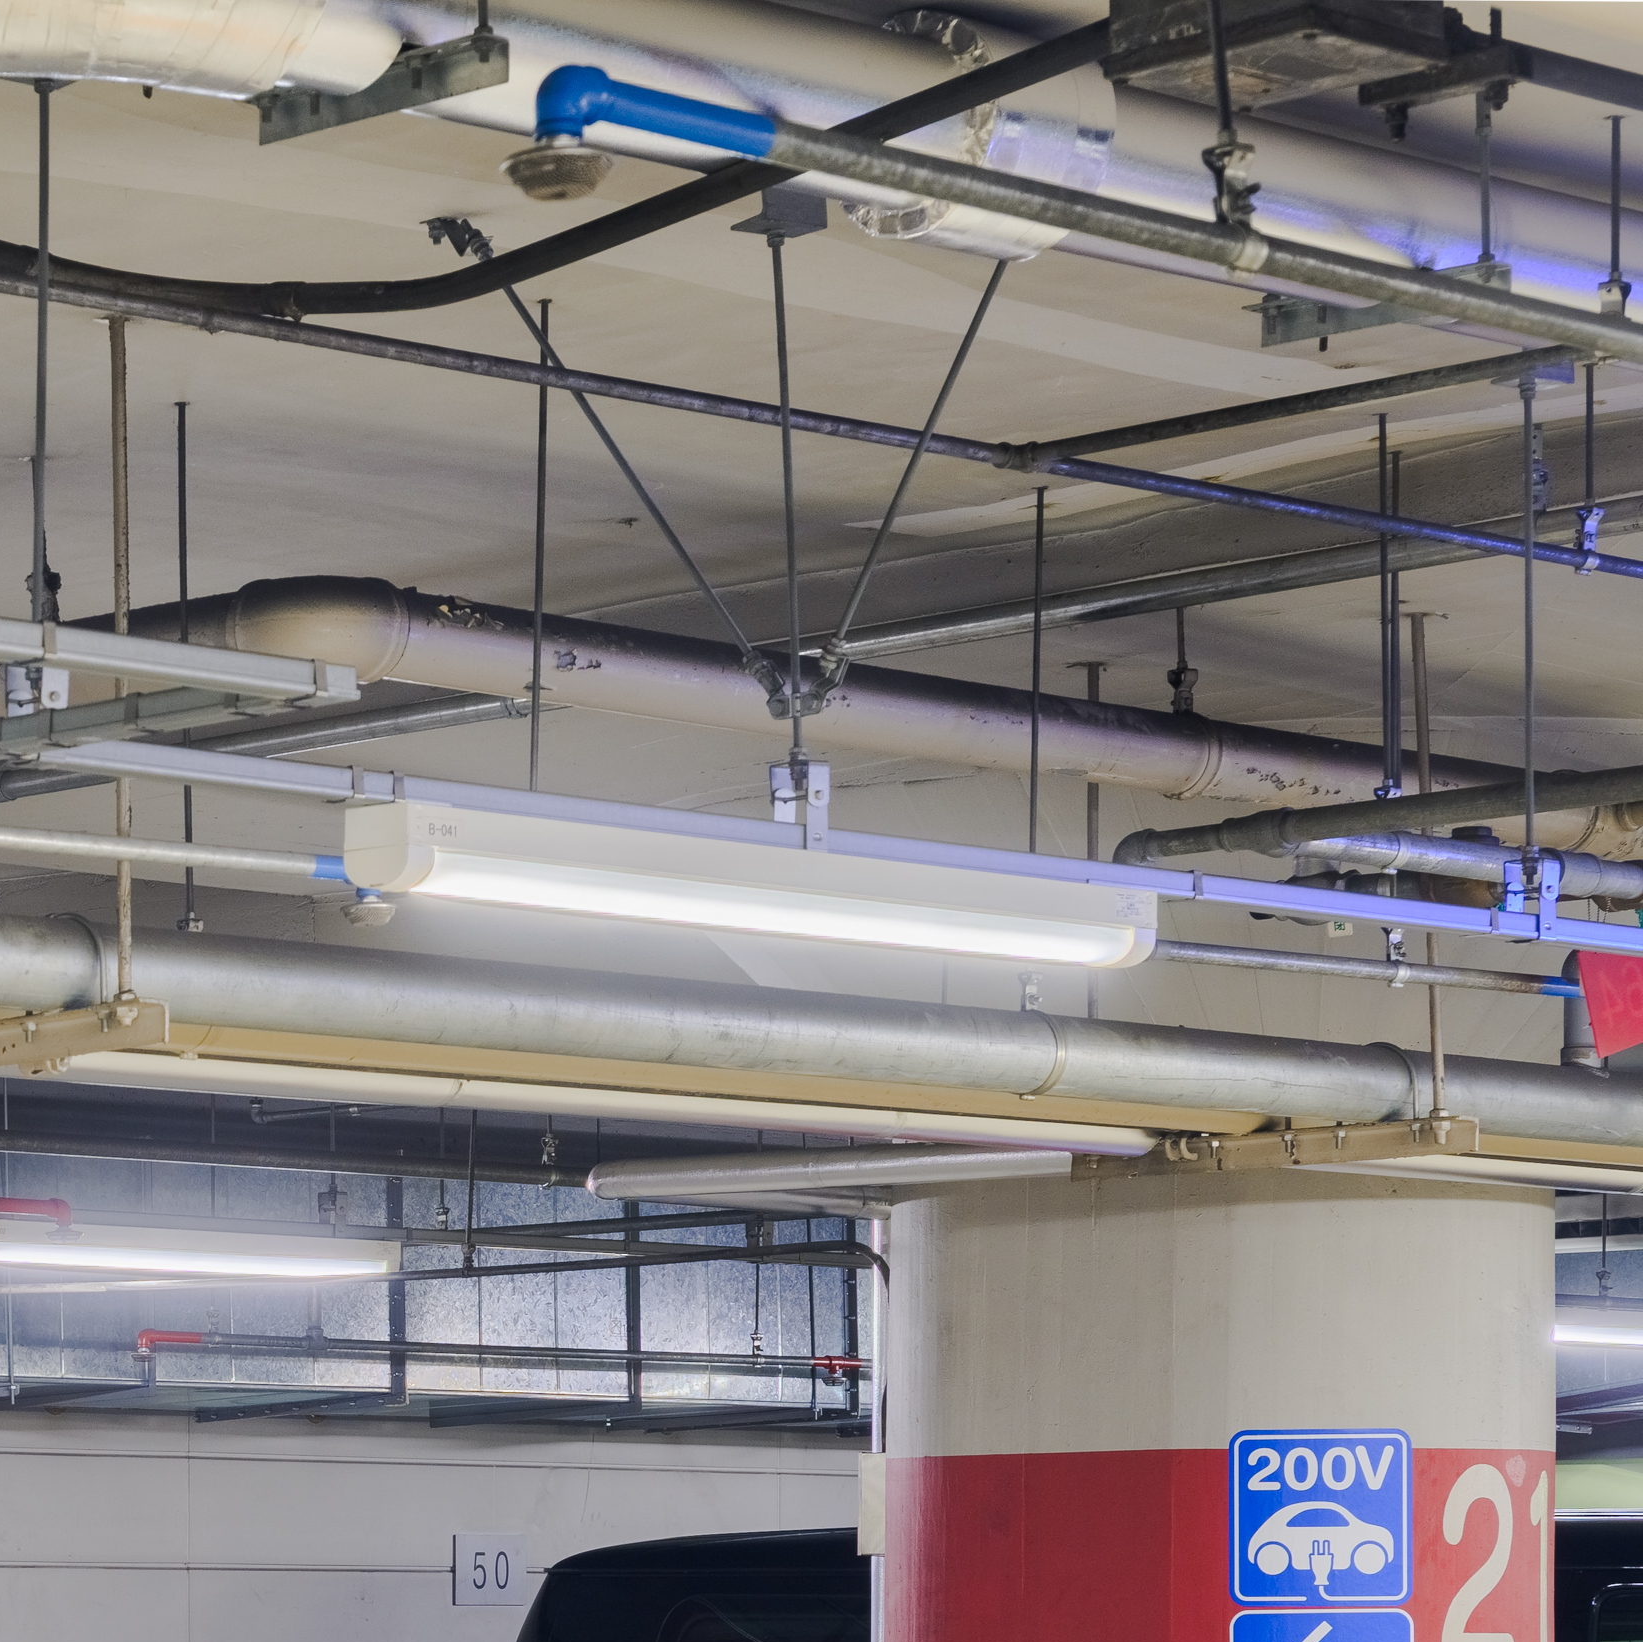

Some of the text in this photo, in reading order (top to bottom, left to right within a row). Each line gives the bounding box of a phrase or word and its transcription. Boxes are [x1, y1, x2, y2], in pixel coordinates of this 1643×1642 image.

[428, 822, 458, 837] B-041
[1246, 1444, 1396, 1493] 200V
[472, 1551, 511, 1591] 50
